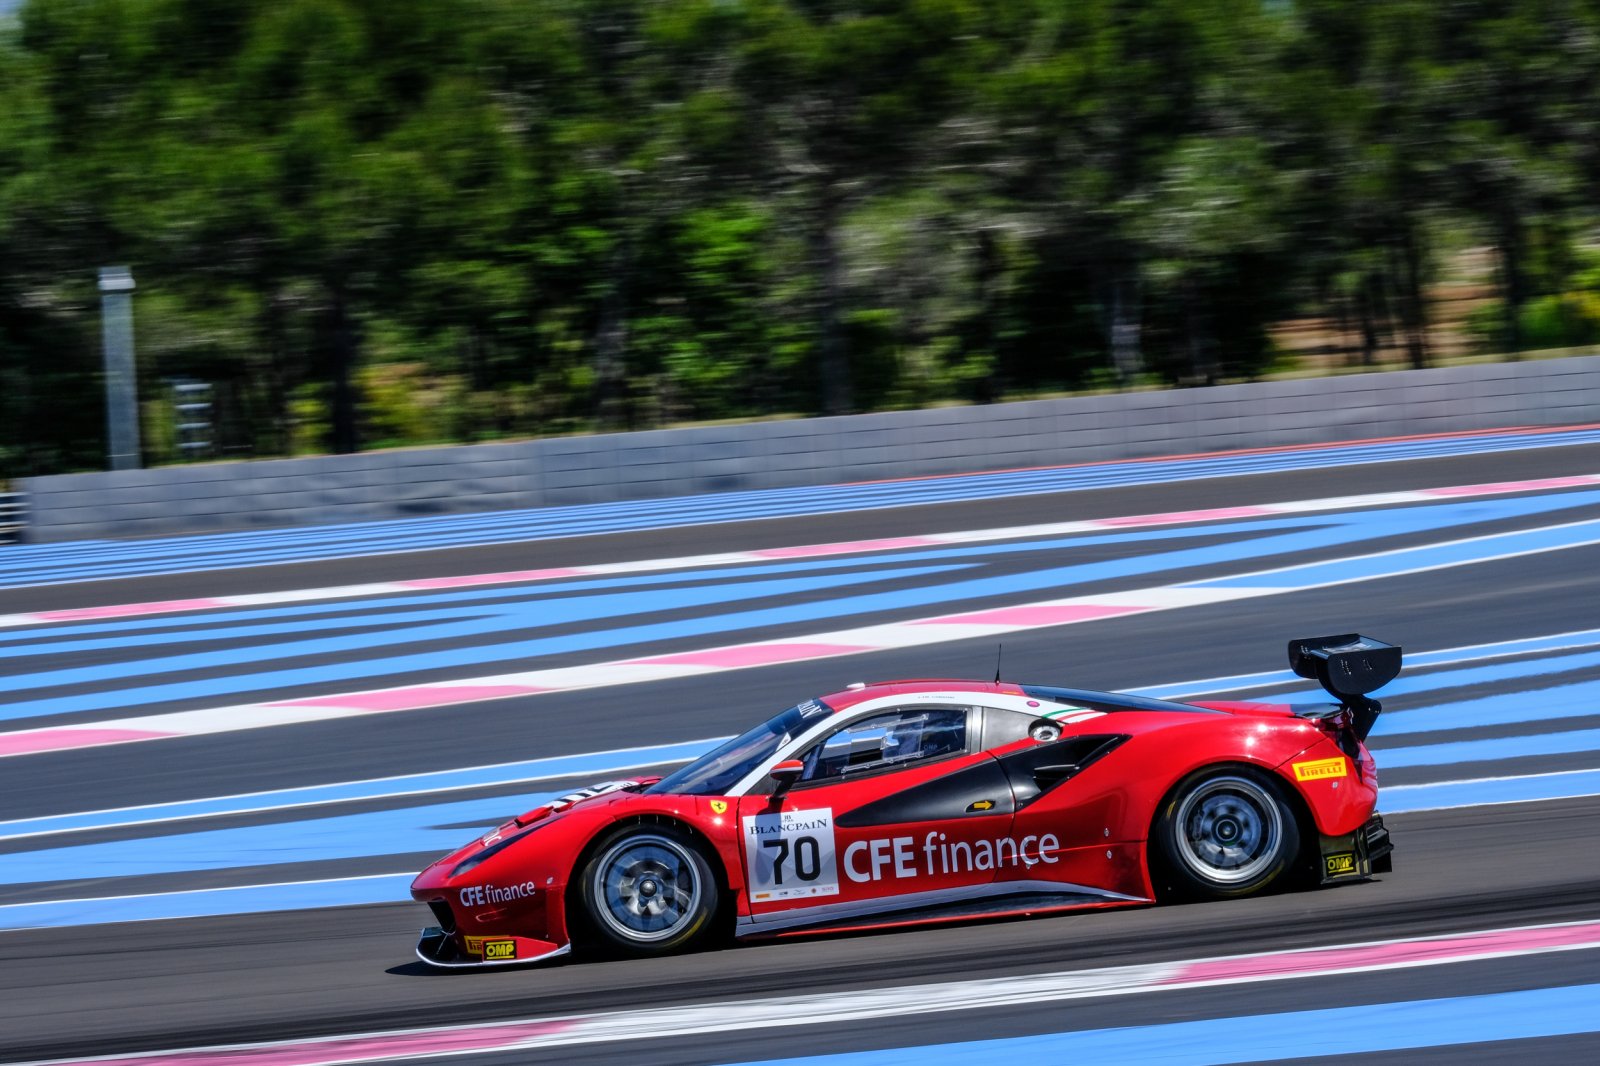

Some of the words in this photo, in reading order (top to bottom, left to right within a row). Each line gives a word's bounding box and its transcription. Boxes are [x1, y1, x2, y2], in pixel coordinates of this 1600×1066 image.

[1298, 761, 1342, 777] PIRELLI
[750, 819, 828, 835] BLANCPAIN
[762, 835, 821, 885] 70
[843, 836, 918, 883] CFE
[923, 831, 1060, 876] finance
[1327, 856, 1353, 870] OMP
[460, 885, 486, 907] CFE
[485, 881, 536, 904] finance
[485, 943, 515, 957] OMP
